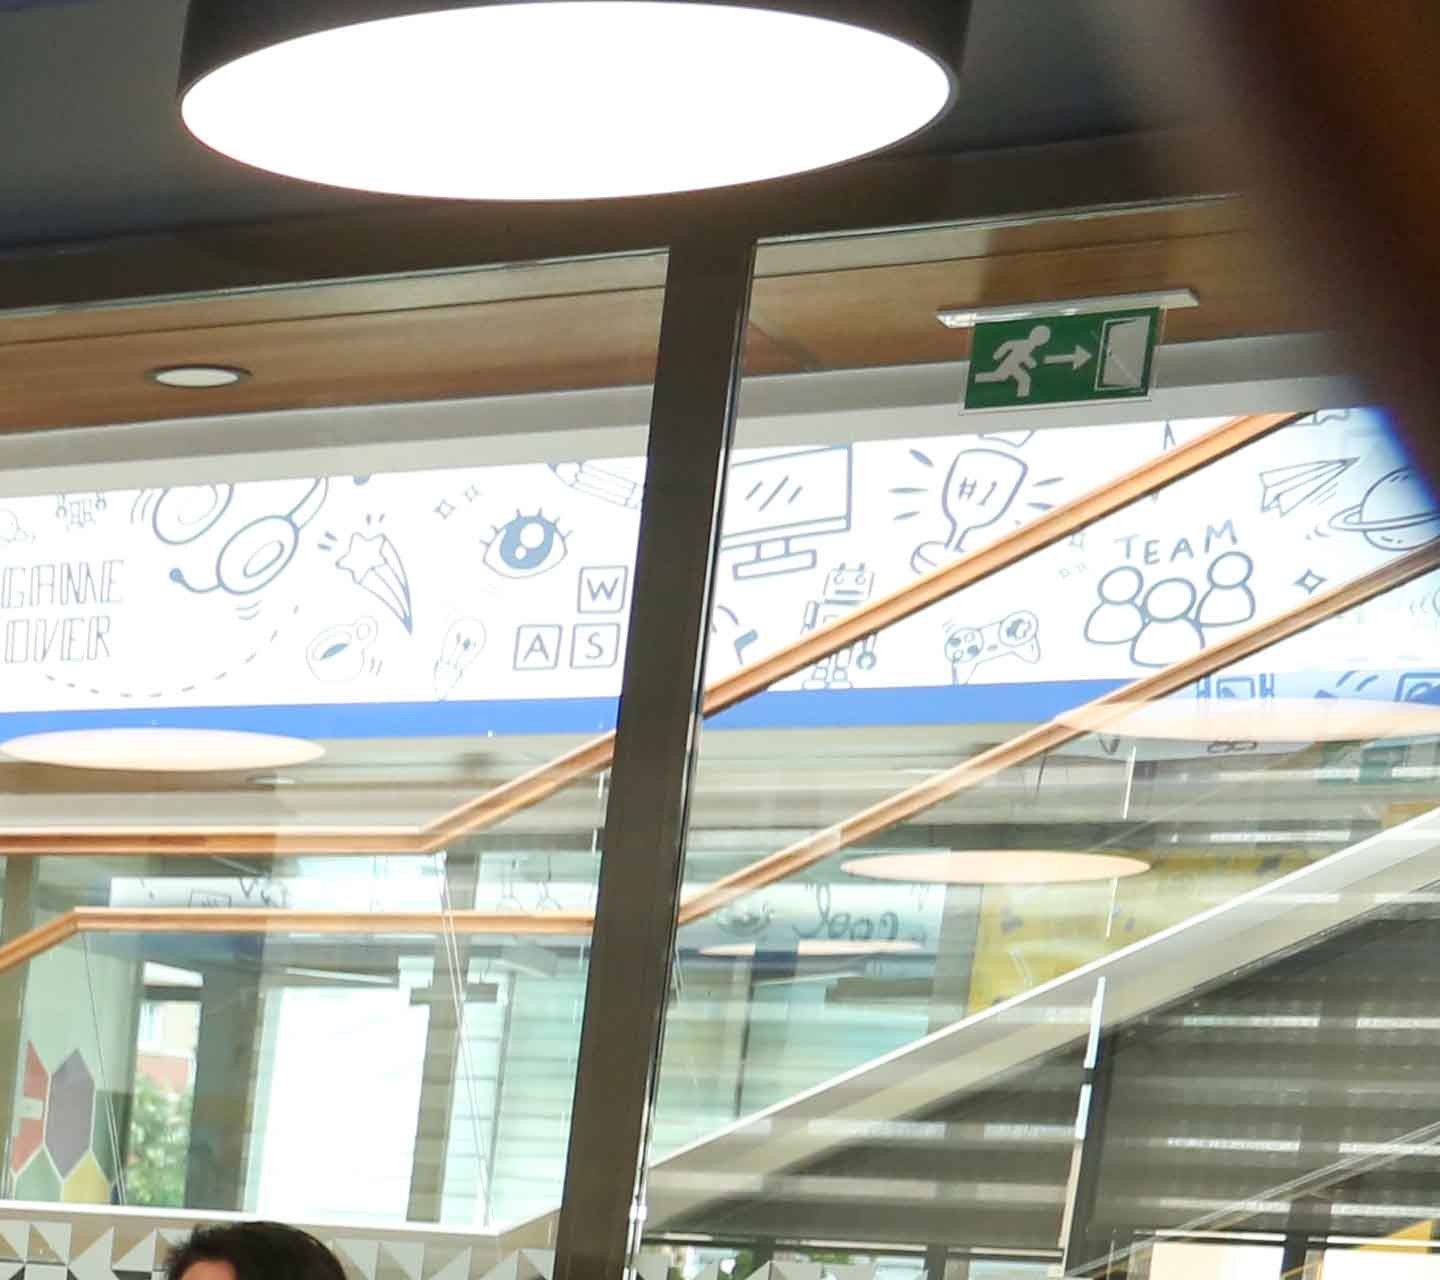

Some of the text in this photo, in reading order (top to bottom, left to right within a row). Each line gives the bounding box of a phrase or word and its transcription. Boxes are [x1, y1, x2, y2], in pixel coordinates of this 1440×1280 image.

[1114, 518, 1240, 567] TEAM
[0, 558, 125, 608] GAME
[586, 576, 619, 601] W
[4, 615, 111, 664] OVER
